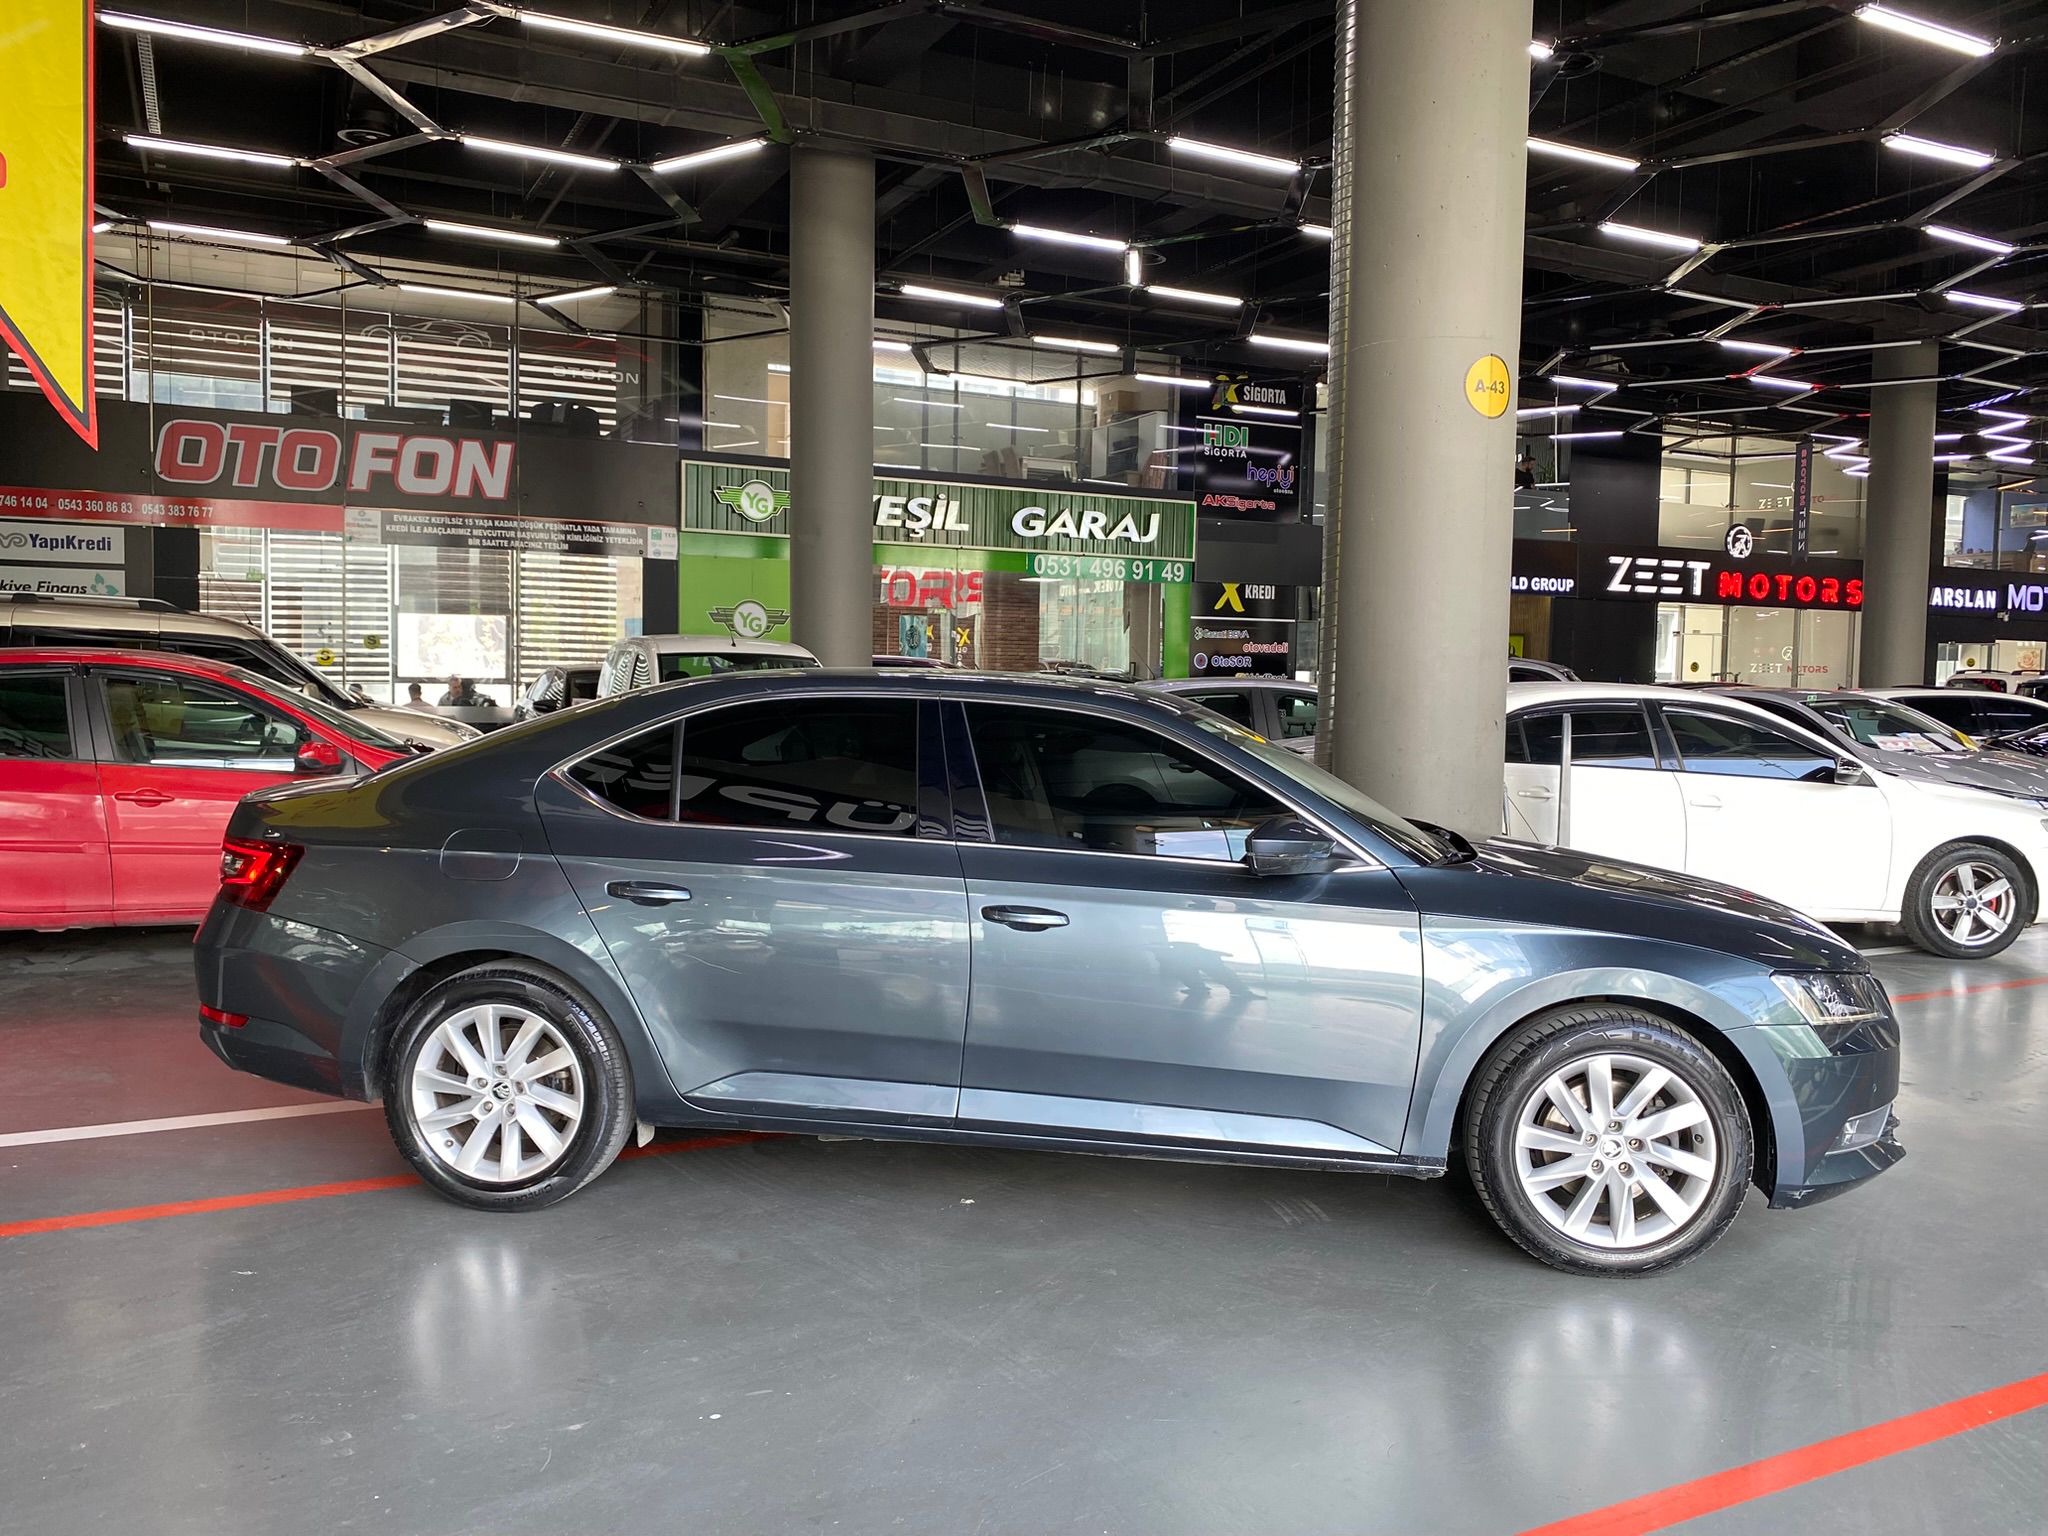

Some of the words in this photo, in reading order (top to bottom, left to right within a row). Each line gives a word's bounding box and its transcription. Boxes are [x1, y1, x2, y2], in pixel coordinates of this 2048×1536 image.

[1474, 379, 1505, 394] A-43
[1203, 423, 1249, 449] HDI
[154, 419, 342, 492] OTO
[347, 431, 515, 500] FON
[21, 496, 33, 508] 14
[35, 496, 48, 509] 04
[58, 498, 83, 511] 0543
[85, 500, 103, 513] 360
[106, 501, 118, 513] 86
[120, 502, 133, 514] 83
[142, 503, 165, 515] 0543
[168, 505, 185, 517] 383
[188, 506, 200, 518] 76
[202, 506, 214, 518] 77
[745, 491, 769, 514] YG
[1759, 496, 1793, 510] ZEET
[873, 493, 970, 538] EŞİL
[1011, 506, 1160, 543] GARAJ
[28, 532, 113, 552] YapıKredi
[1034, 553, 1082, 576] 0531
[1089, 558, 1127, 579] 496
[1132, 560, 1154, 580] 91
[1161, 562, 1185, 582] 49
[1510, 576, 1529, 590] LD
[1530, 576, 1575, 592] GROUP
[1606, 555, 1711, 597] ZEET
[1716, 570, 1864, 606] MOTORS
[1929, 586, 1997, 609] ARSLAN
[738, 611, 762, 633] YG
[1242, 642, 1289, 654] otovadeli
